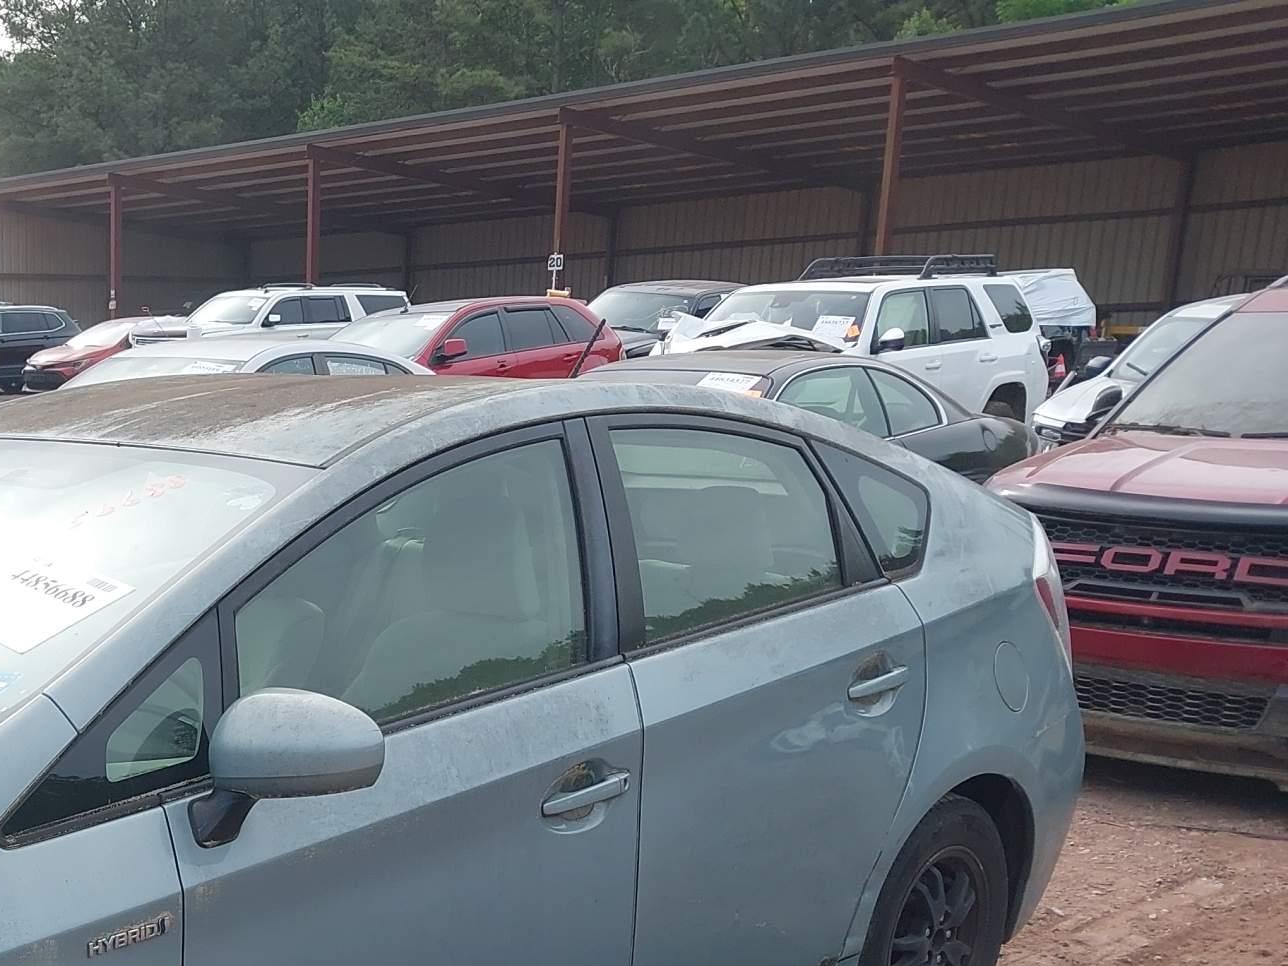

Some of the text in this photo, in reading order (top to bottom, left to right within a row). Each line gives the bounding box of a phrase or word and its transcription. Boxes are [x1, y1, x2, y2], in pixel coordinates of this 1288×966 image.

[548, 256, 562, 268] 20
[1050, 542, 1288, 587] FORD
[10, 569, 96, 608] 44856688
[87, 922, 159, 959] HYBRID
